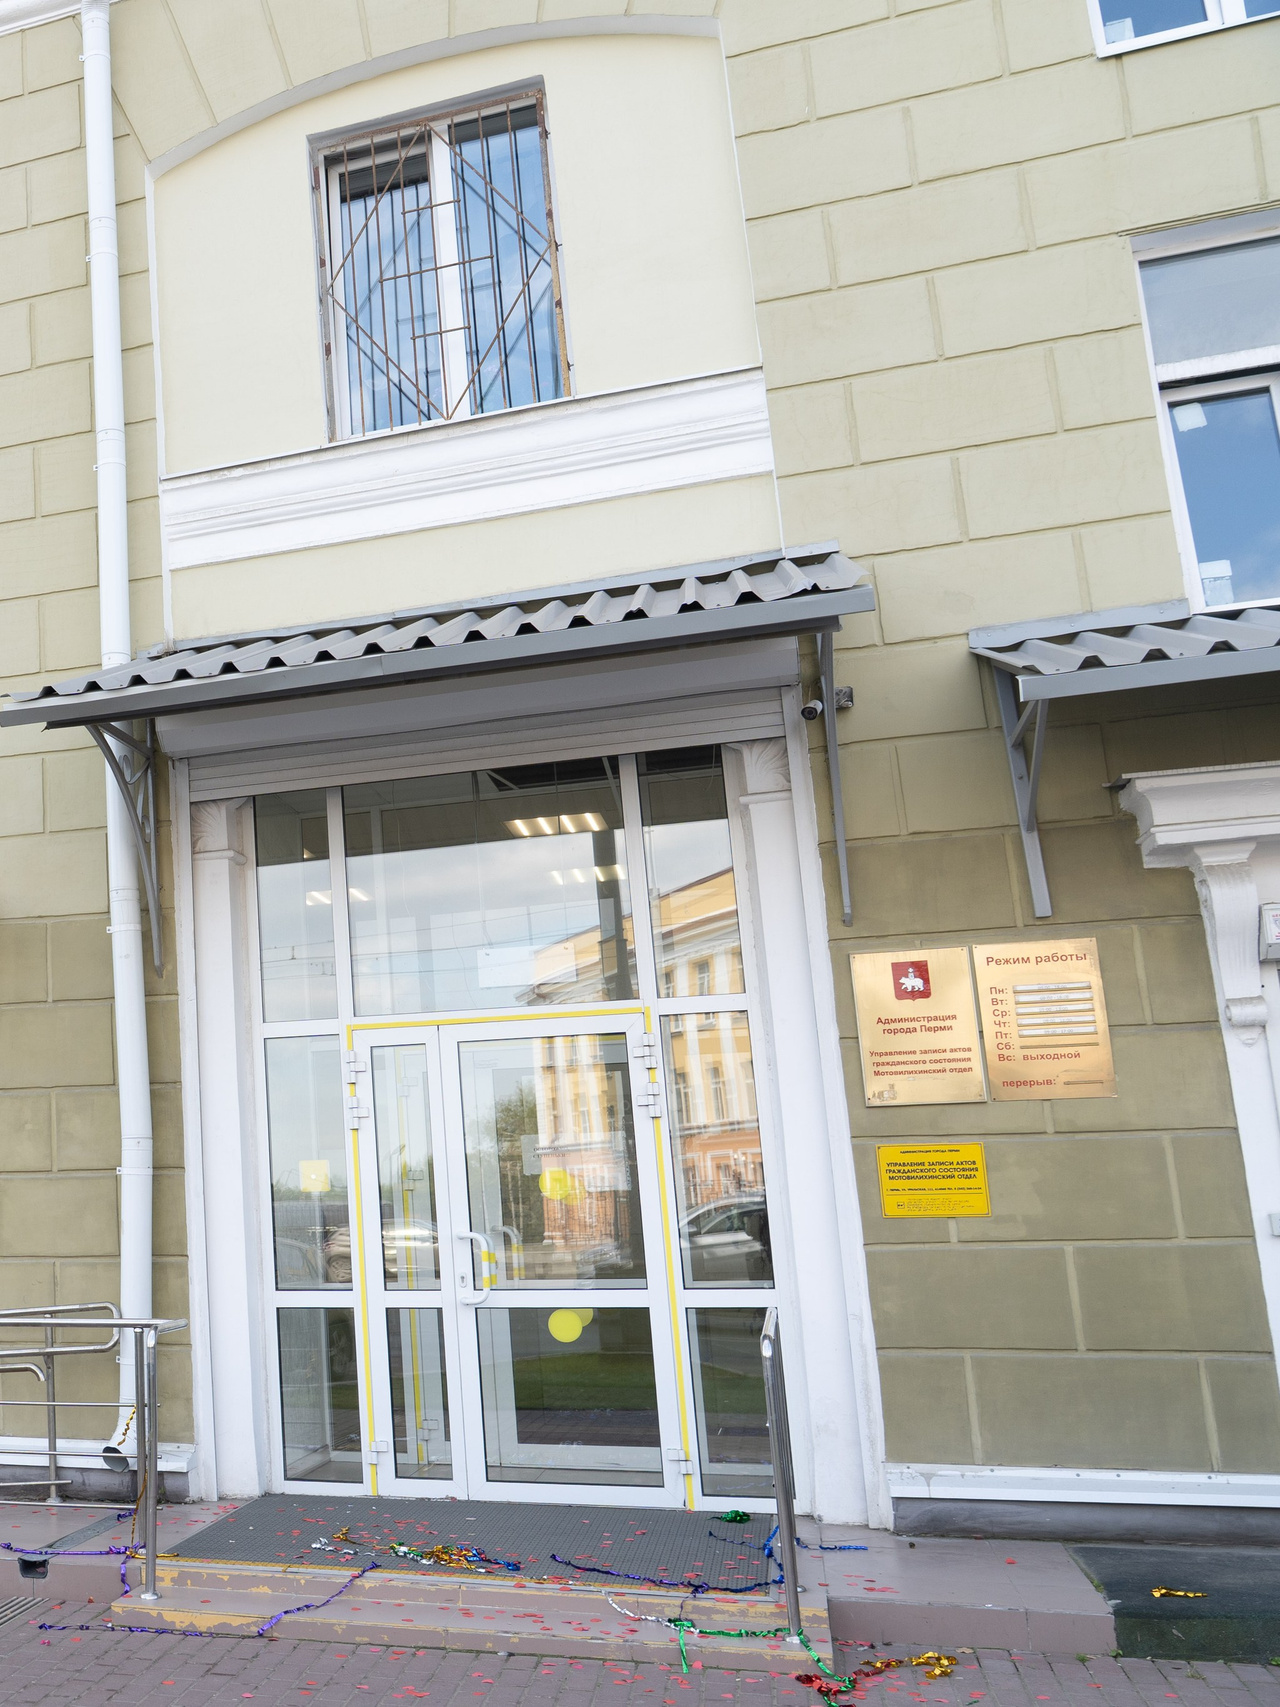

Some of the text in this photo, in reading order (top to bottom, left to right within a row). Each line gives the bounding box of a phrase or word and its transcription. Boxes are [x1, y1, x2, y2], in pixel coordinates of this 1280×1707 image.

[986, 952, 1087, 966] Режим работы
[989, 986, 1008, 995] Пн:
[991, 997, 1008, 1006] Вт:
[992, 1008, 1011, 1018] Ср:
[876, 1014, 957, 1025] Администрация
[994, 1020, 1011, 1028] Чт:
[882, 1024, 953, 1036] города Перми
[995, 1031, 1012, 1039] Пт:
[996, 1042, 1015, 1051] Сб:
[869, 1049, 917, 1057] Управление
[997, 1050, 1081, 1062] Вс: выходной
[872, 1059, 927, 1067] гражданского
[873, 1066, 947, 1076] Мотовилихинский
[1002, 1078, 1057, 1088] перерыв:
